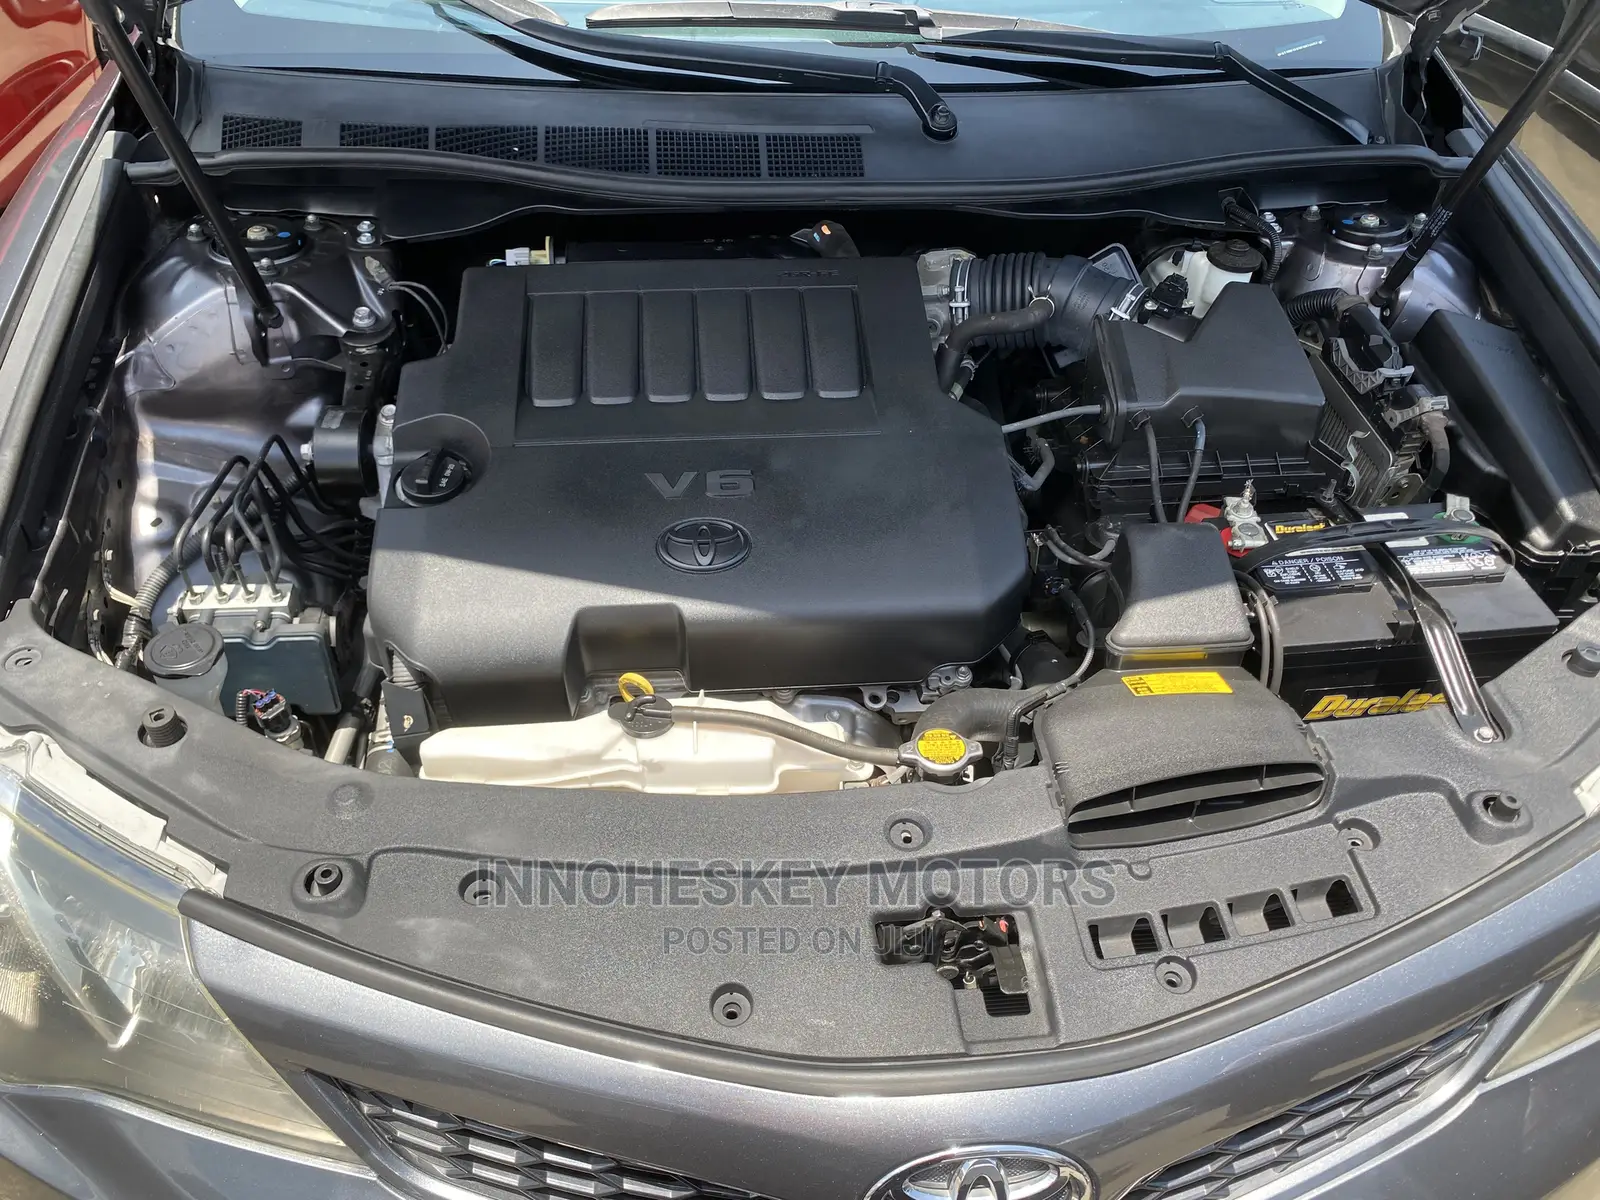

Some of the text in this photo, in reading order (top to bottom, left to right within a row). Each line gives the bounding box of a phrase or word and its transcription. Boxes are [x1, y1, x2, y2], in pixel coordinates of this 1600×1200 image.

[643, 469, 755, 500] V6
[1275, 522, 1326, 534] Duralast
[1278, 557, 1310, 566] DANGER
[1315, 555, 1344, 563] POISON
[1302, 688, 1447, 721] Durala
